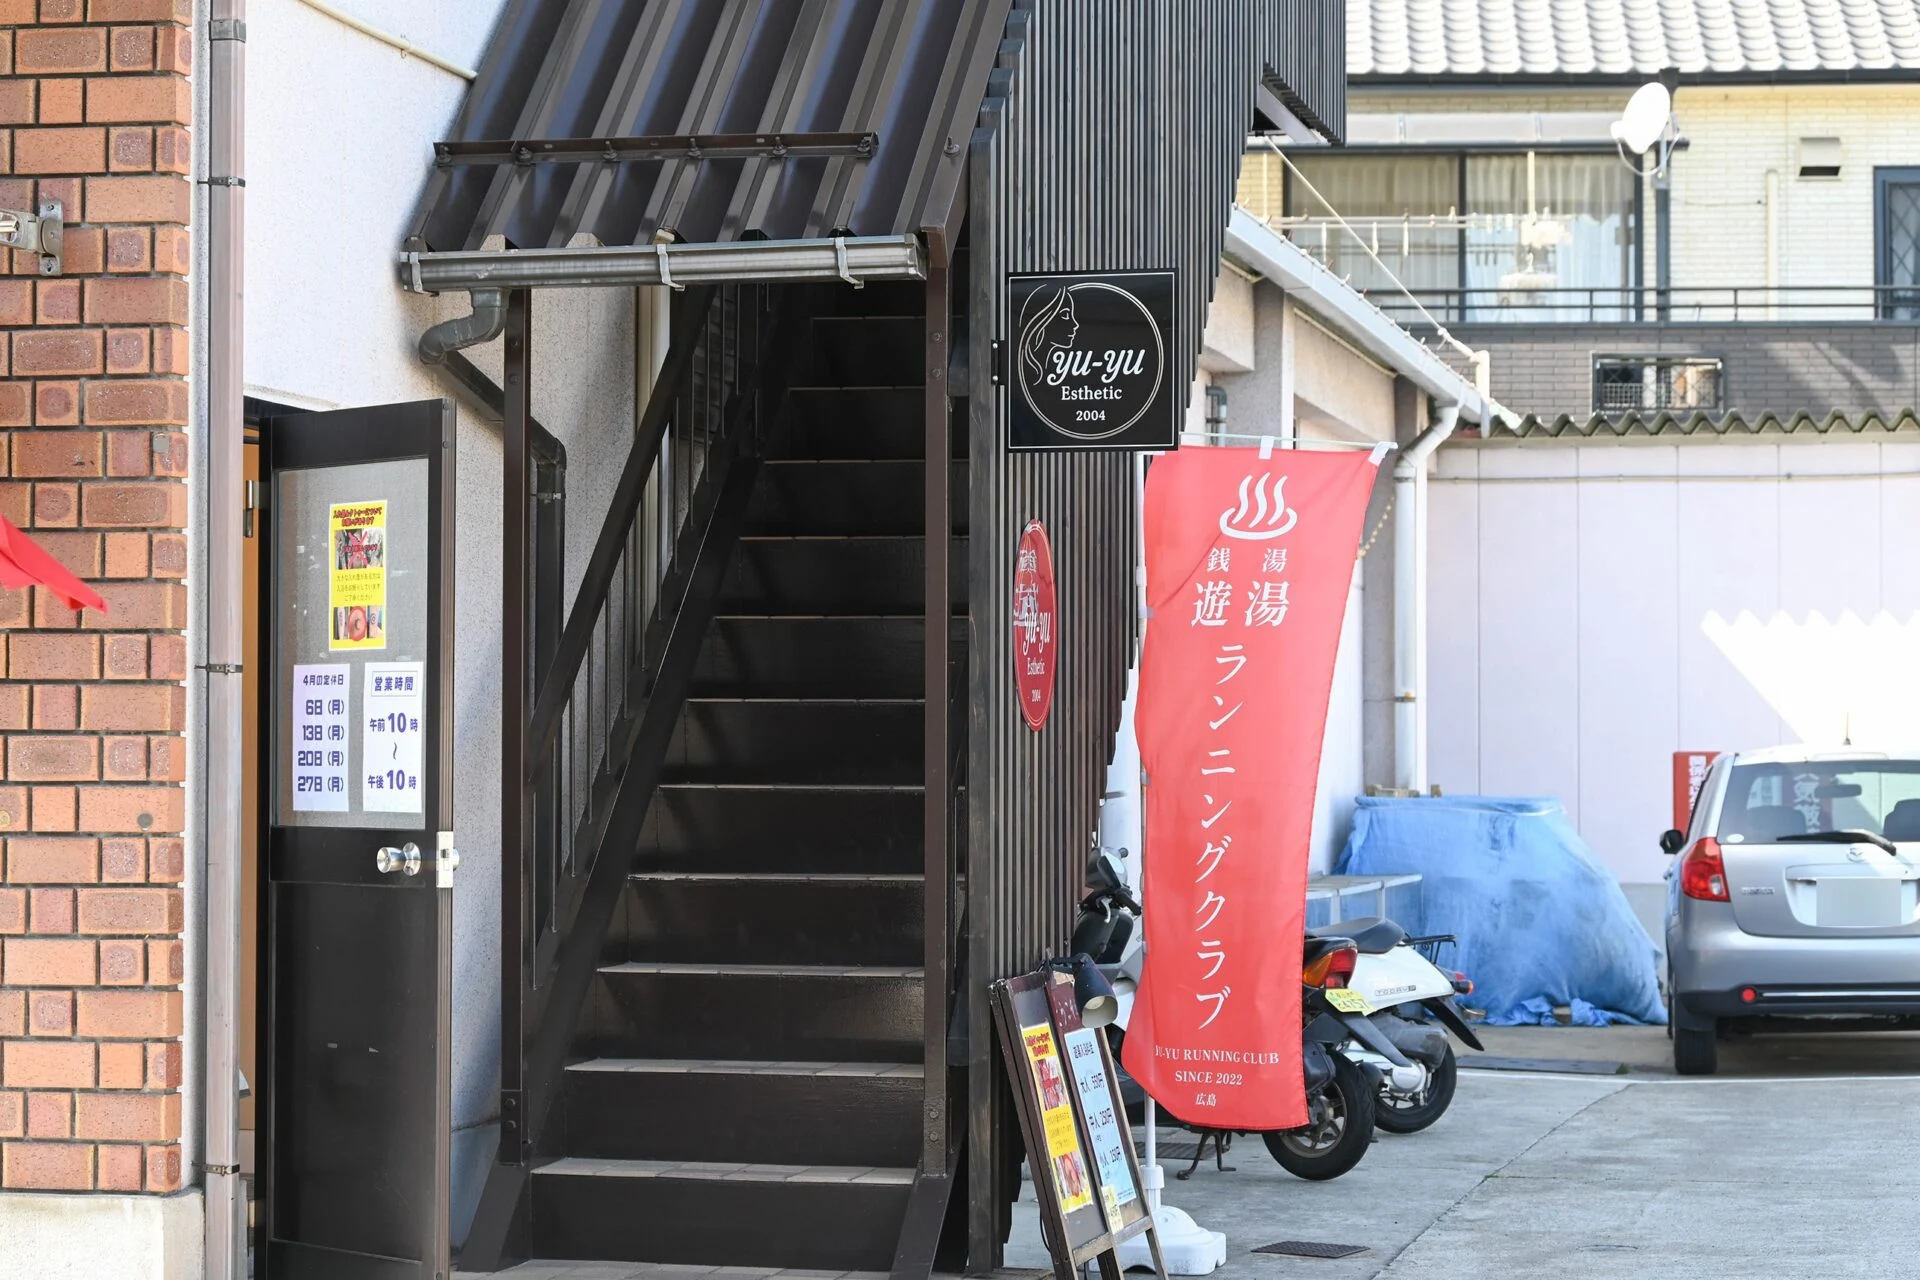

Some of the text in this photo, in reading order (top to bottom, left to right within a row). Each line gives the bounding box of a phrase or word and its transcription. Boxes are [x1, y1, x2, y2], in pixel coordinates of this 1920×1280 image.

[1061, 385, 1123, 401] Esthetic
[1075, 409, 1106, 421] 2004
[1206, 547, 1288, 573] 銭湯
[1191, 580, 1290, 627] 遊湯
[1027, 657, 1045, 675] Esthetic
[302, 674, 344, 687] 4月の定休日
[374, 676, 414, 692] 営業時間
[1031, 689, 1041, 702] 2004
[1195, 644, 1248, 1029] ランニングクラブ
[1183, 1049, 1241, 1063] RUNNING
[1243, 1052, 1280, 1065] CLUB
[1175, 1071, 1243, 1086] SINCE 2022
[1195, 1093, 1217, 1107] 広島
